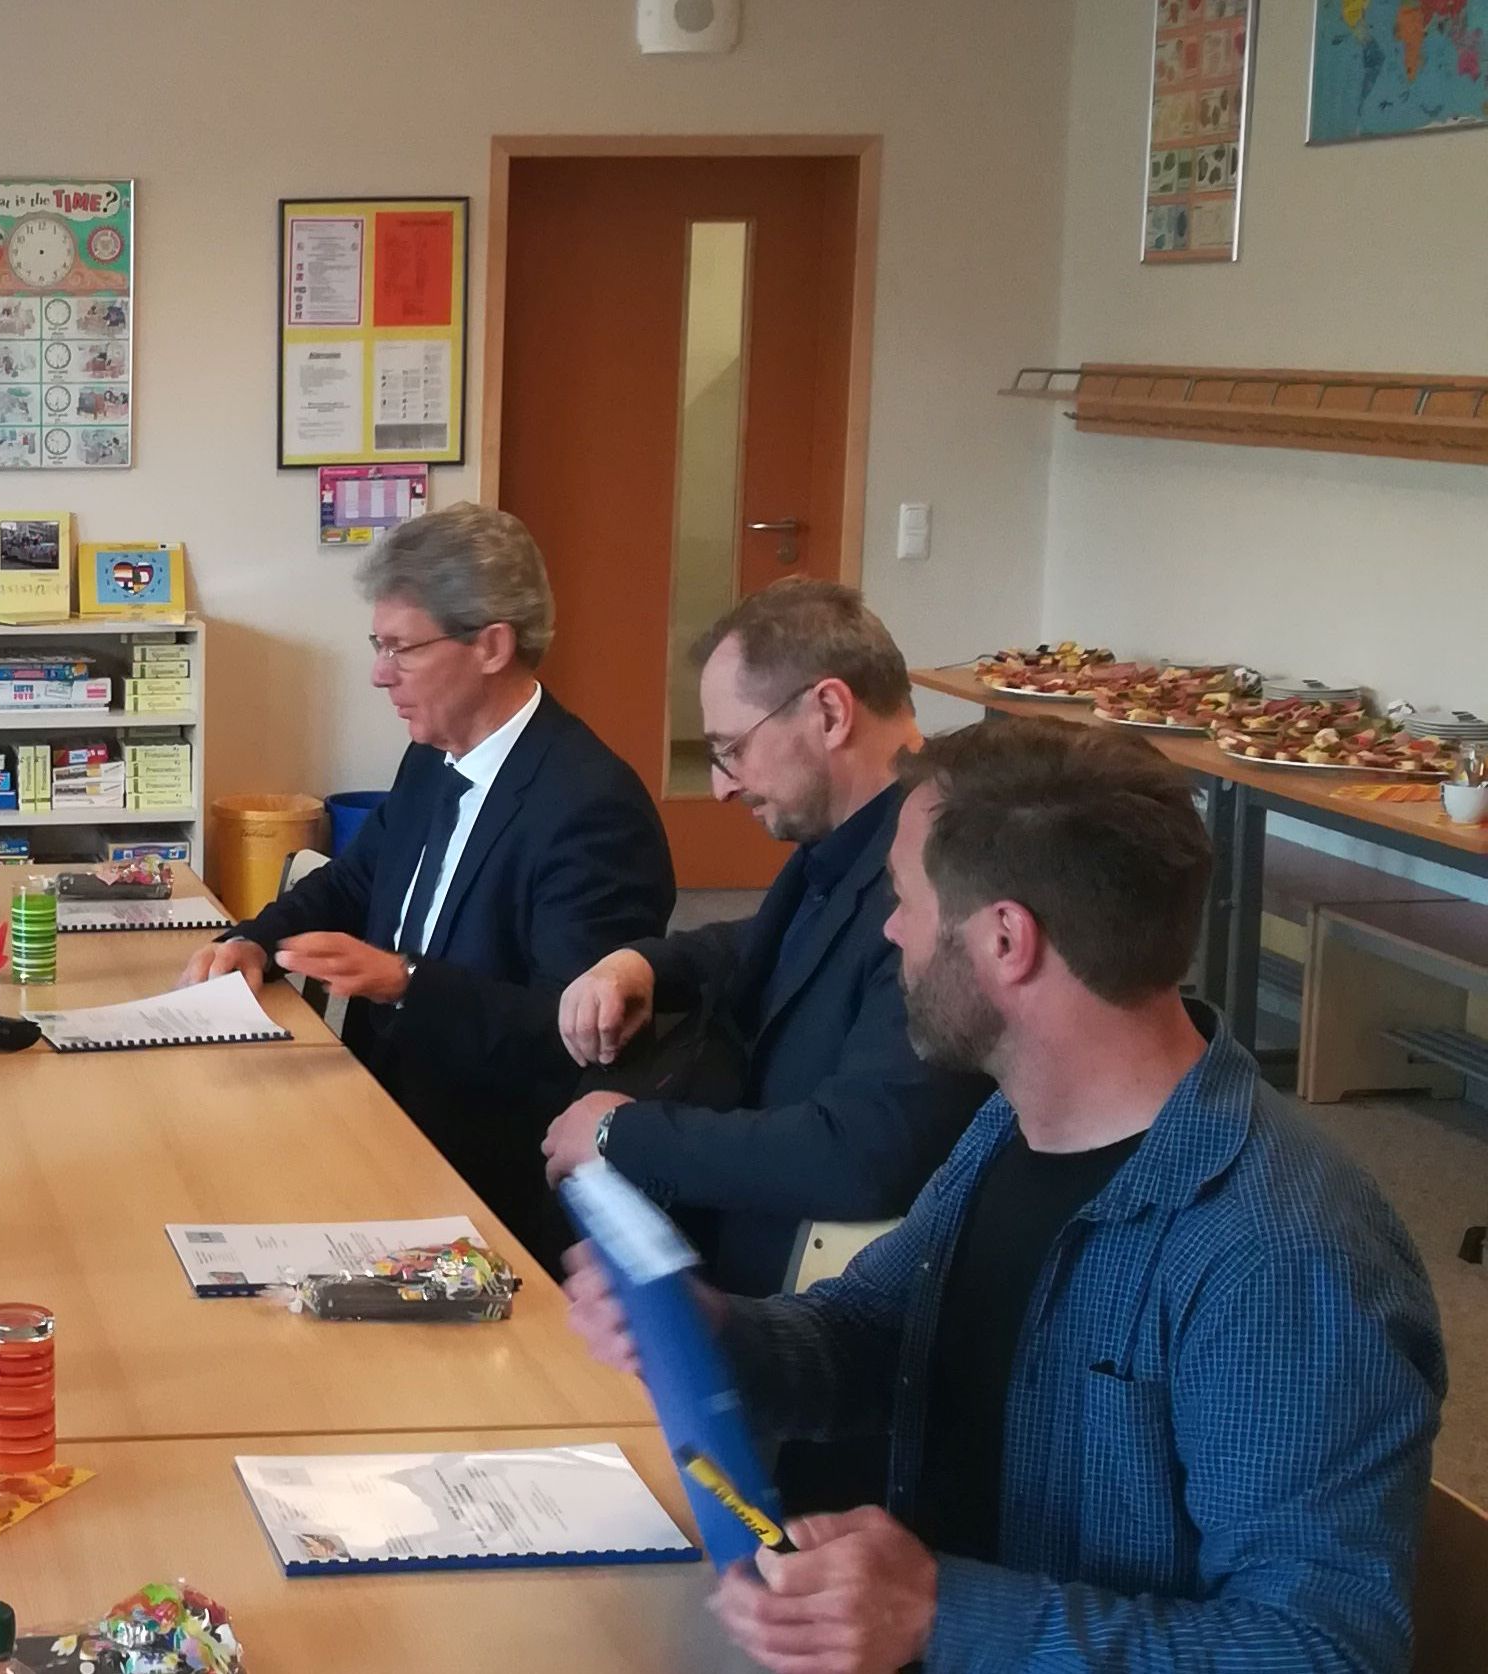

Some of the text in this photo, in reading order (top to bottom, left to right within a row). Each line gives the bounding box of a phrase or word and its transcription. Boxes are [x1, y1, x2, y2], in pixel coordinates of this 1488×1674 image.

[15, 194, 26, 207] is
[30, 193, 50, 207] the
[53, 189, 119, 213] TIME?
